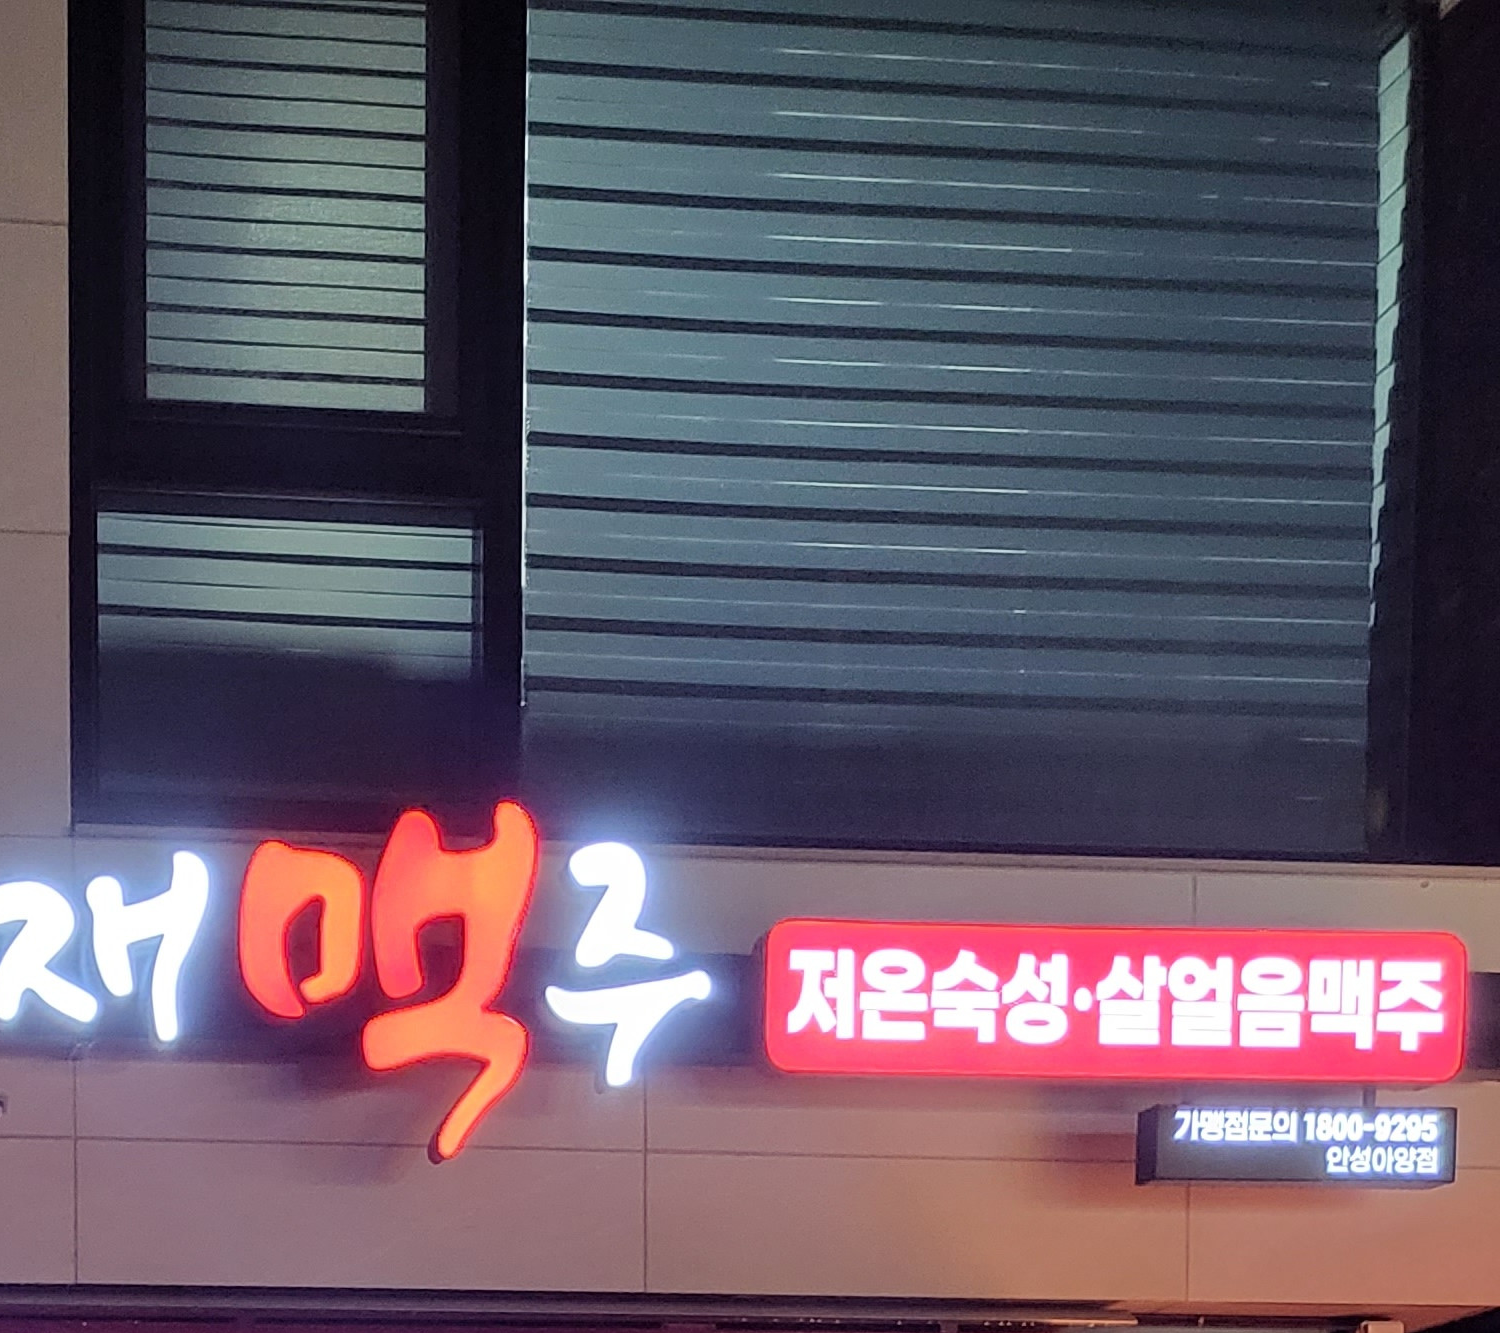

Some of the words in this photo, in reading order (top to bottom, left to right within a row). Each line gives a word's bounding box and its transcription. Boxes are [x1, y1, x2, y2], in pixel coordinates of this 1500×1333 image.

[1173, 1109, 1299, 1144] 가맹점문의
[1303, 1110, 1438, 1143] 1800-9295
[1326, 1146, 1438, 1175] 안성아양점
